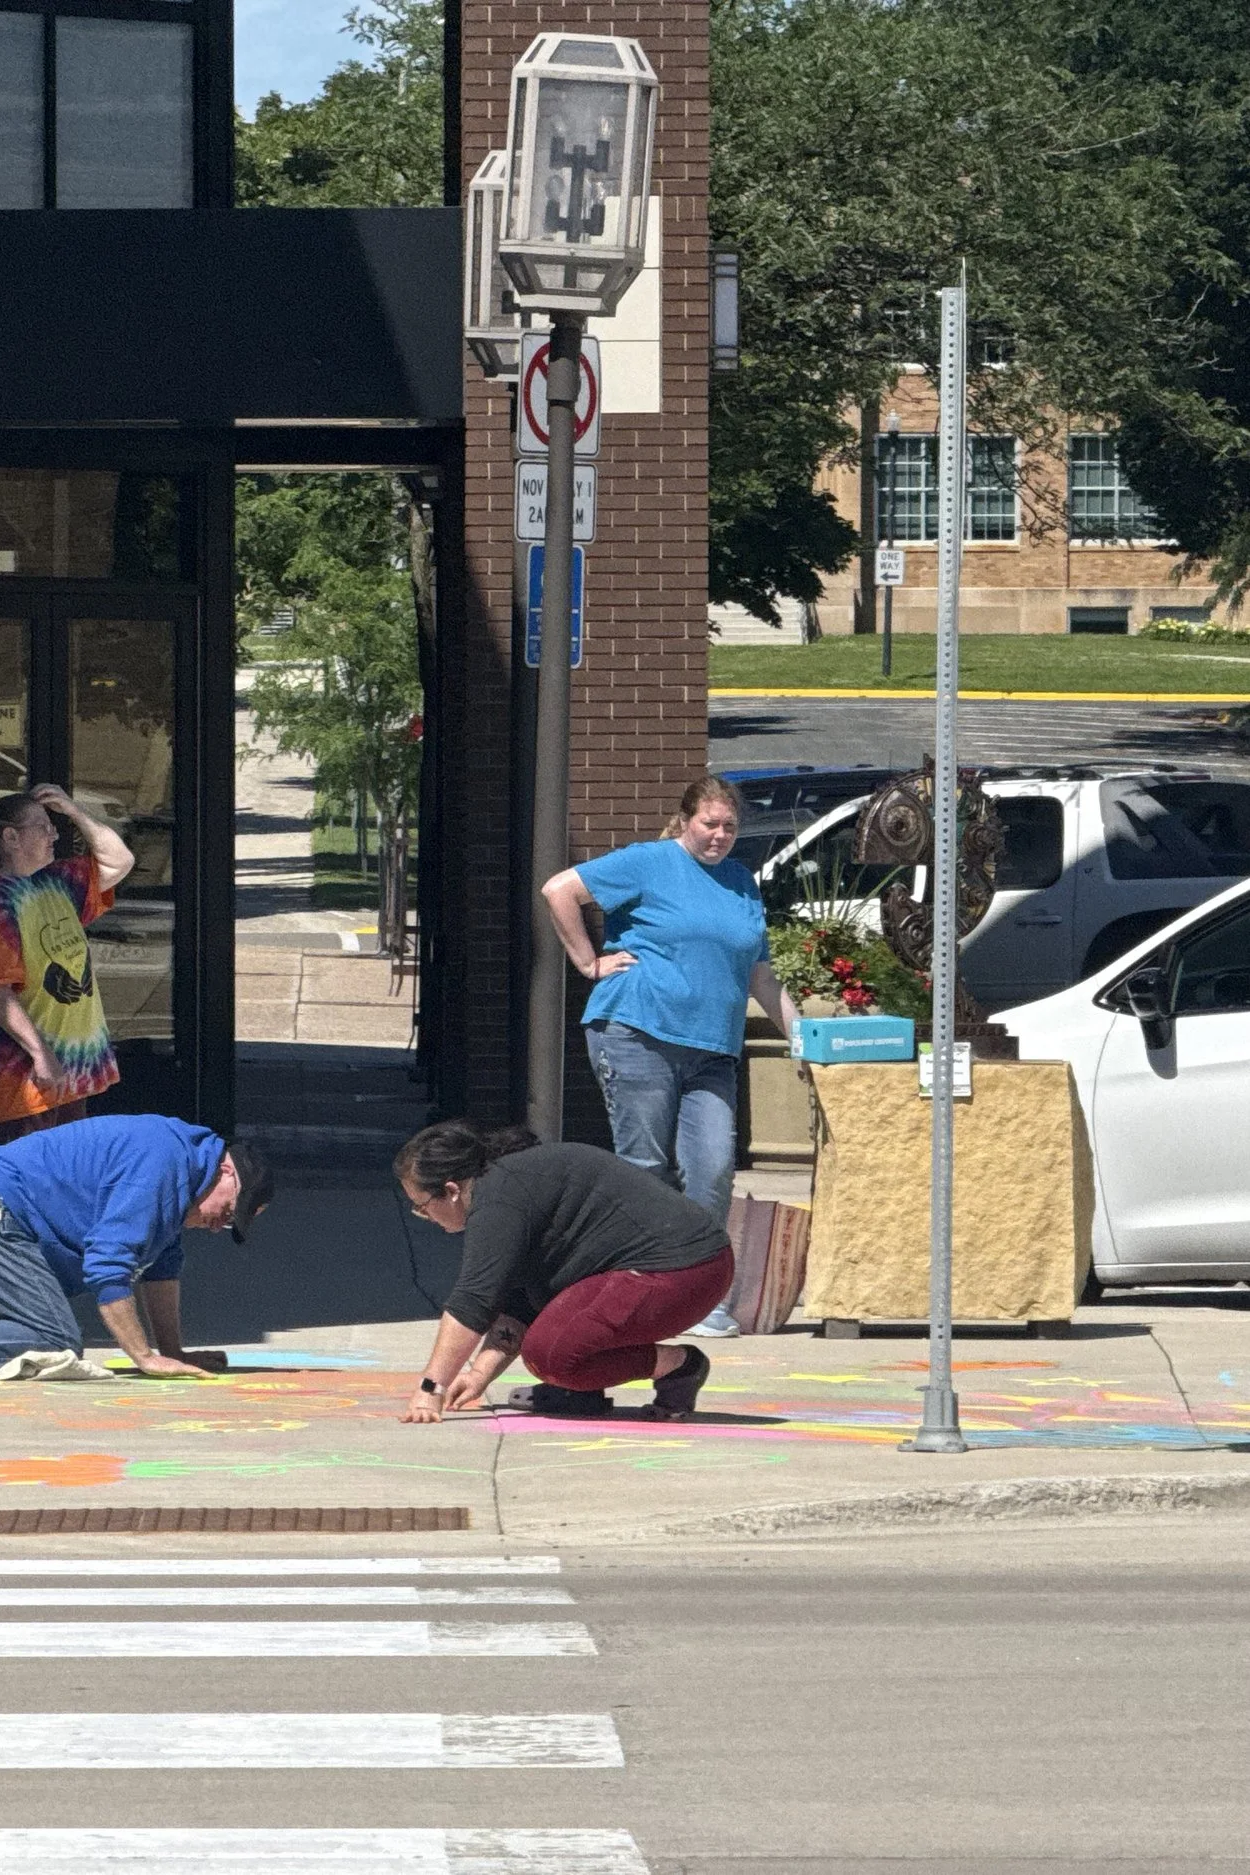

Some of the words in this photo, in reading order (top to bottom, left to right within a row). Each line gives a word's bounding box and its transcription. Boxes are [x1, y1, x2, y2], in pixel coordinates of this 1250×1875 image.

[523, 479, 544, 496] NOV
[528, 507, 544, 523] 2A
[881, 552, 900, 561] ONE
[880, 562, 900, 570] WAY
